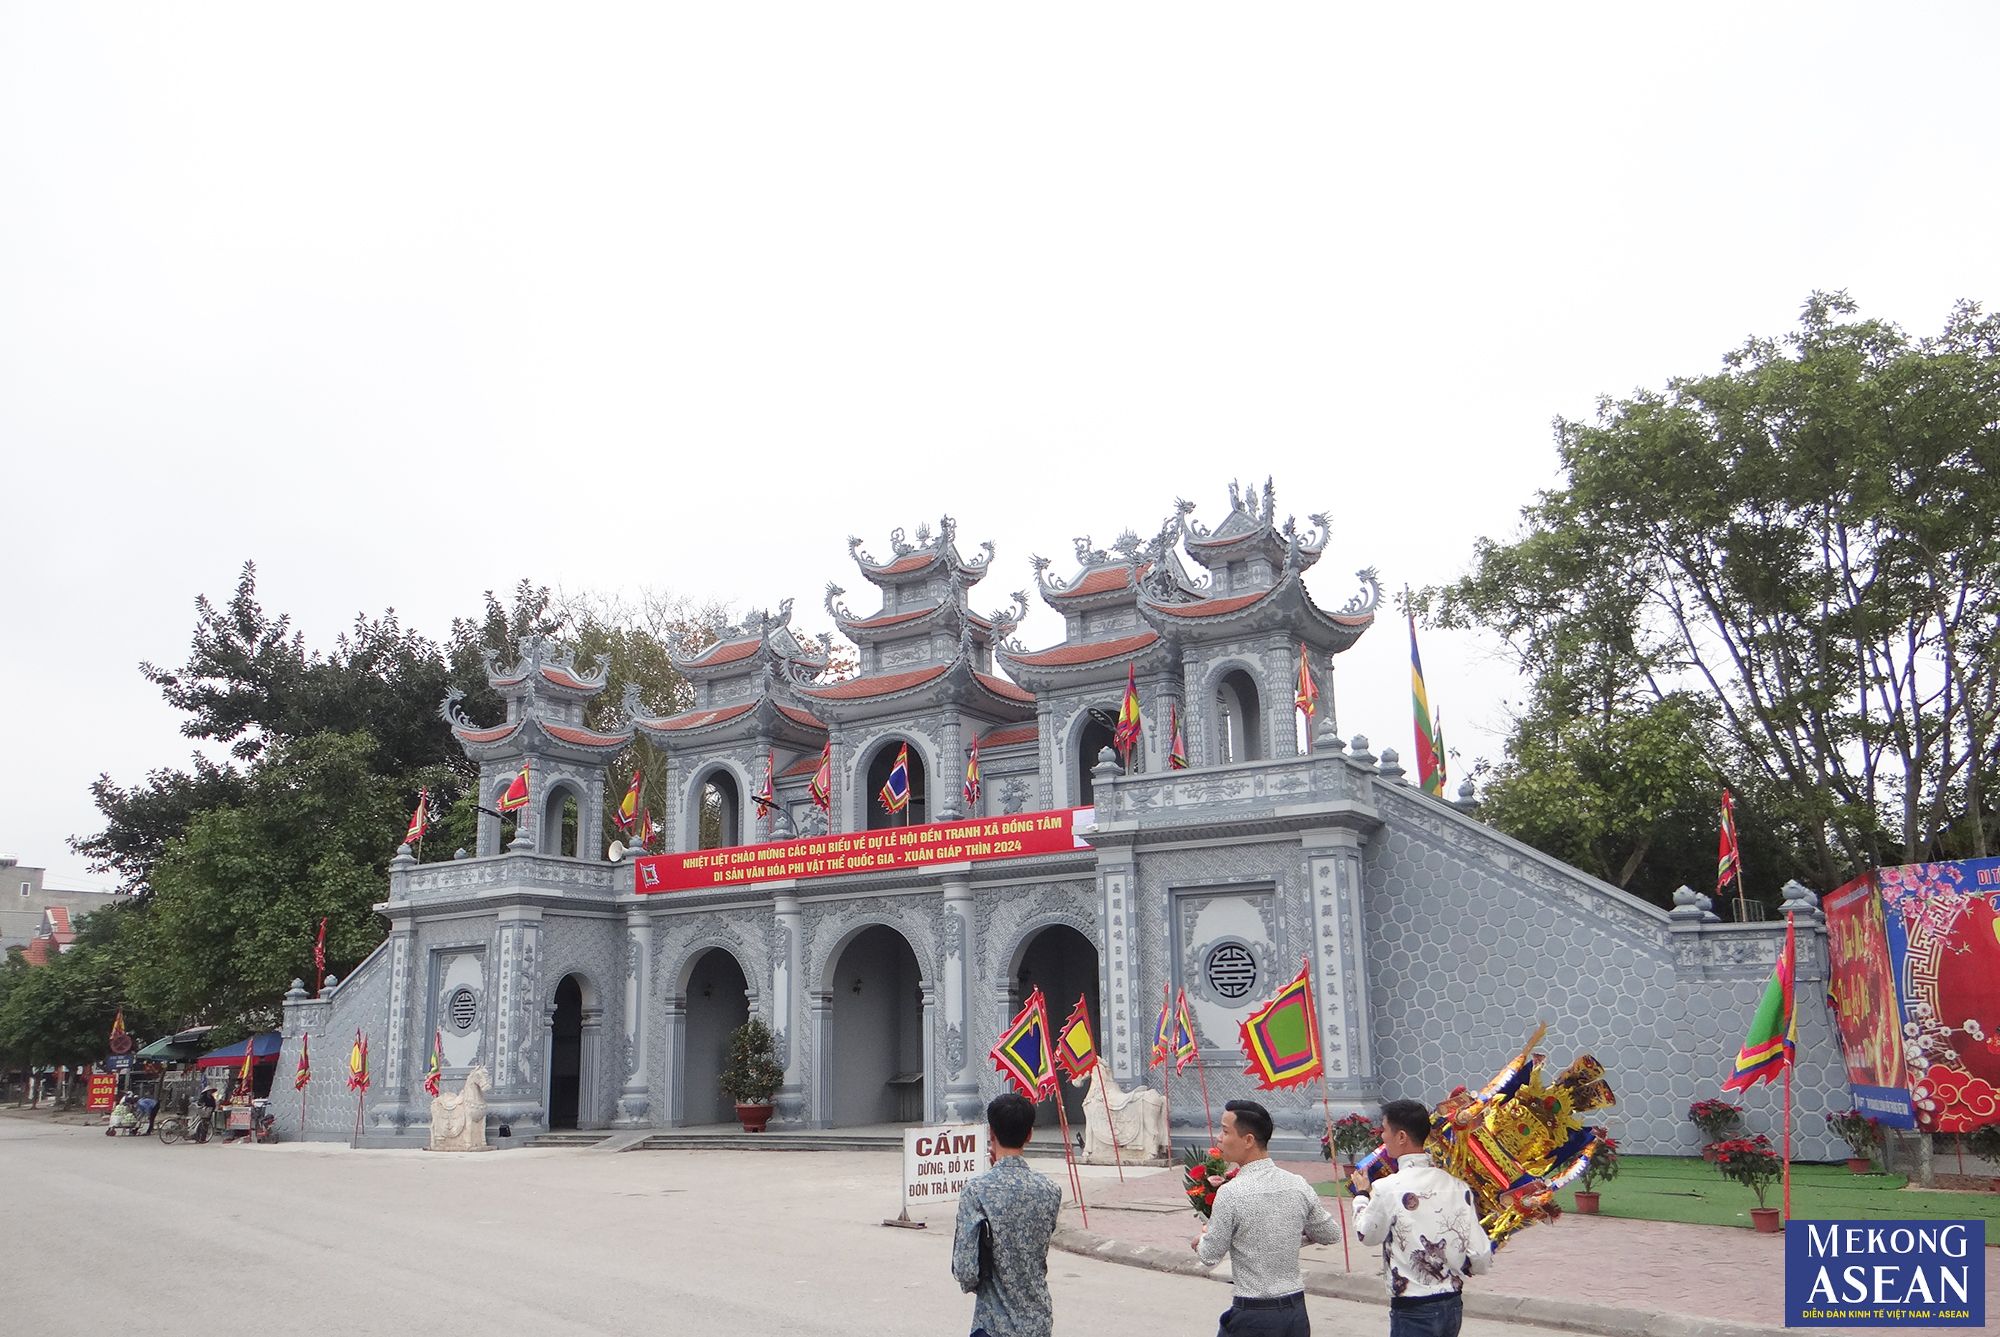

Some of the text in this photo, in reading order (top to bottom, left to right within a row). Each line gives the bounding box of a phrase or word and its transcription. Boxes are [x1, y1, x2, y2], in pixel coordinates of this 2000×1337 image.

[683, 817, 1062, 869] NHIỆT LIỆT CHÀO MỪNG CÁC ĐẠI BIỂU VỀ DỰ LỄ HỘI ĐỀN TRANH XÃ ĐỒNG TÂM
[713, 871, 723, 882] DI
[725, 866, 744, 880] SẢN
[746, 865, 765, 879] VĂN
[767, 862, 786, 876] HÓA
[788, 862, 804, 874] PHI
[806, 860, 824, 874] VẬT
[826, 854, 844, 870] THỂ
[847, 852, 874, 868] QUỐC
[877, 851, 895, 864] GIA
[904, 847, 934, 862] XUÂN
[936, 845, 962, 859] GIÁP
[964, 841, 992, 856] THÌN
[993, 840, 1022, 853] 2024
[1977, 869, 1992, 885] DI
[915, 1130, 976, 1157] CẤM
[918, 1160, 946, 1176] DỪNG,
[963, 1159, 975, 1172] XE
[909, 1180, 928, 1197] ĐÓN
[931, 1177, 948, 1195] TRẢ
